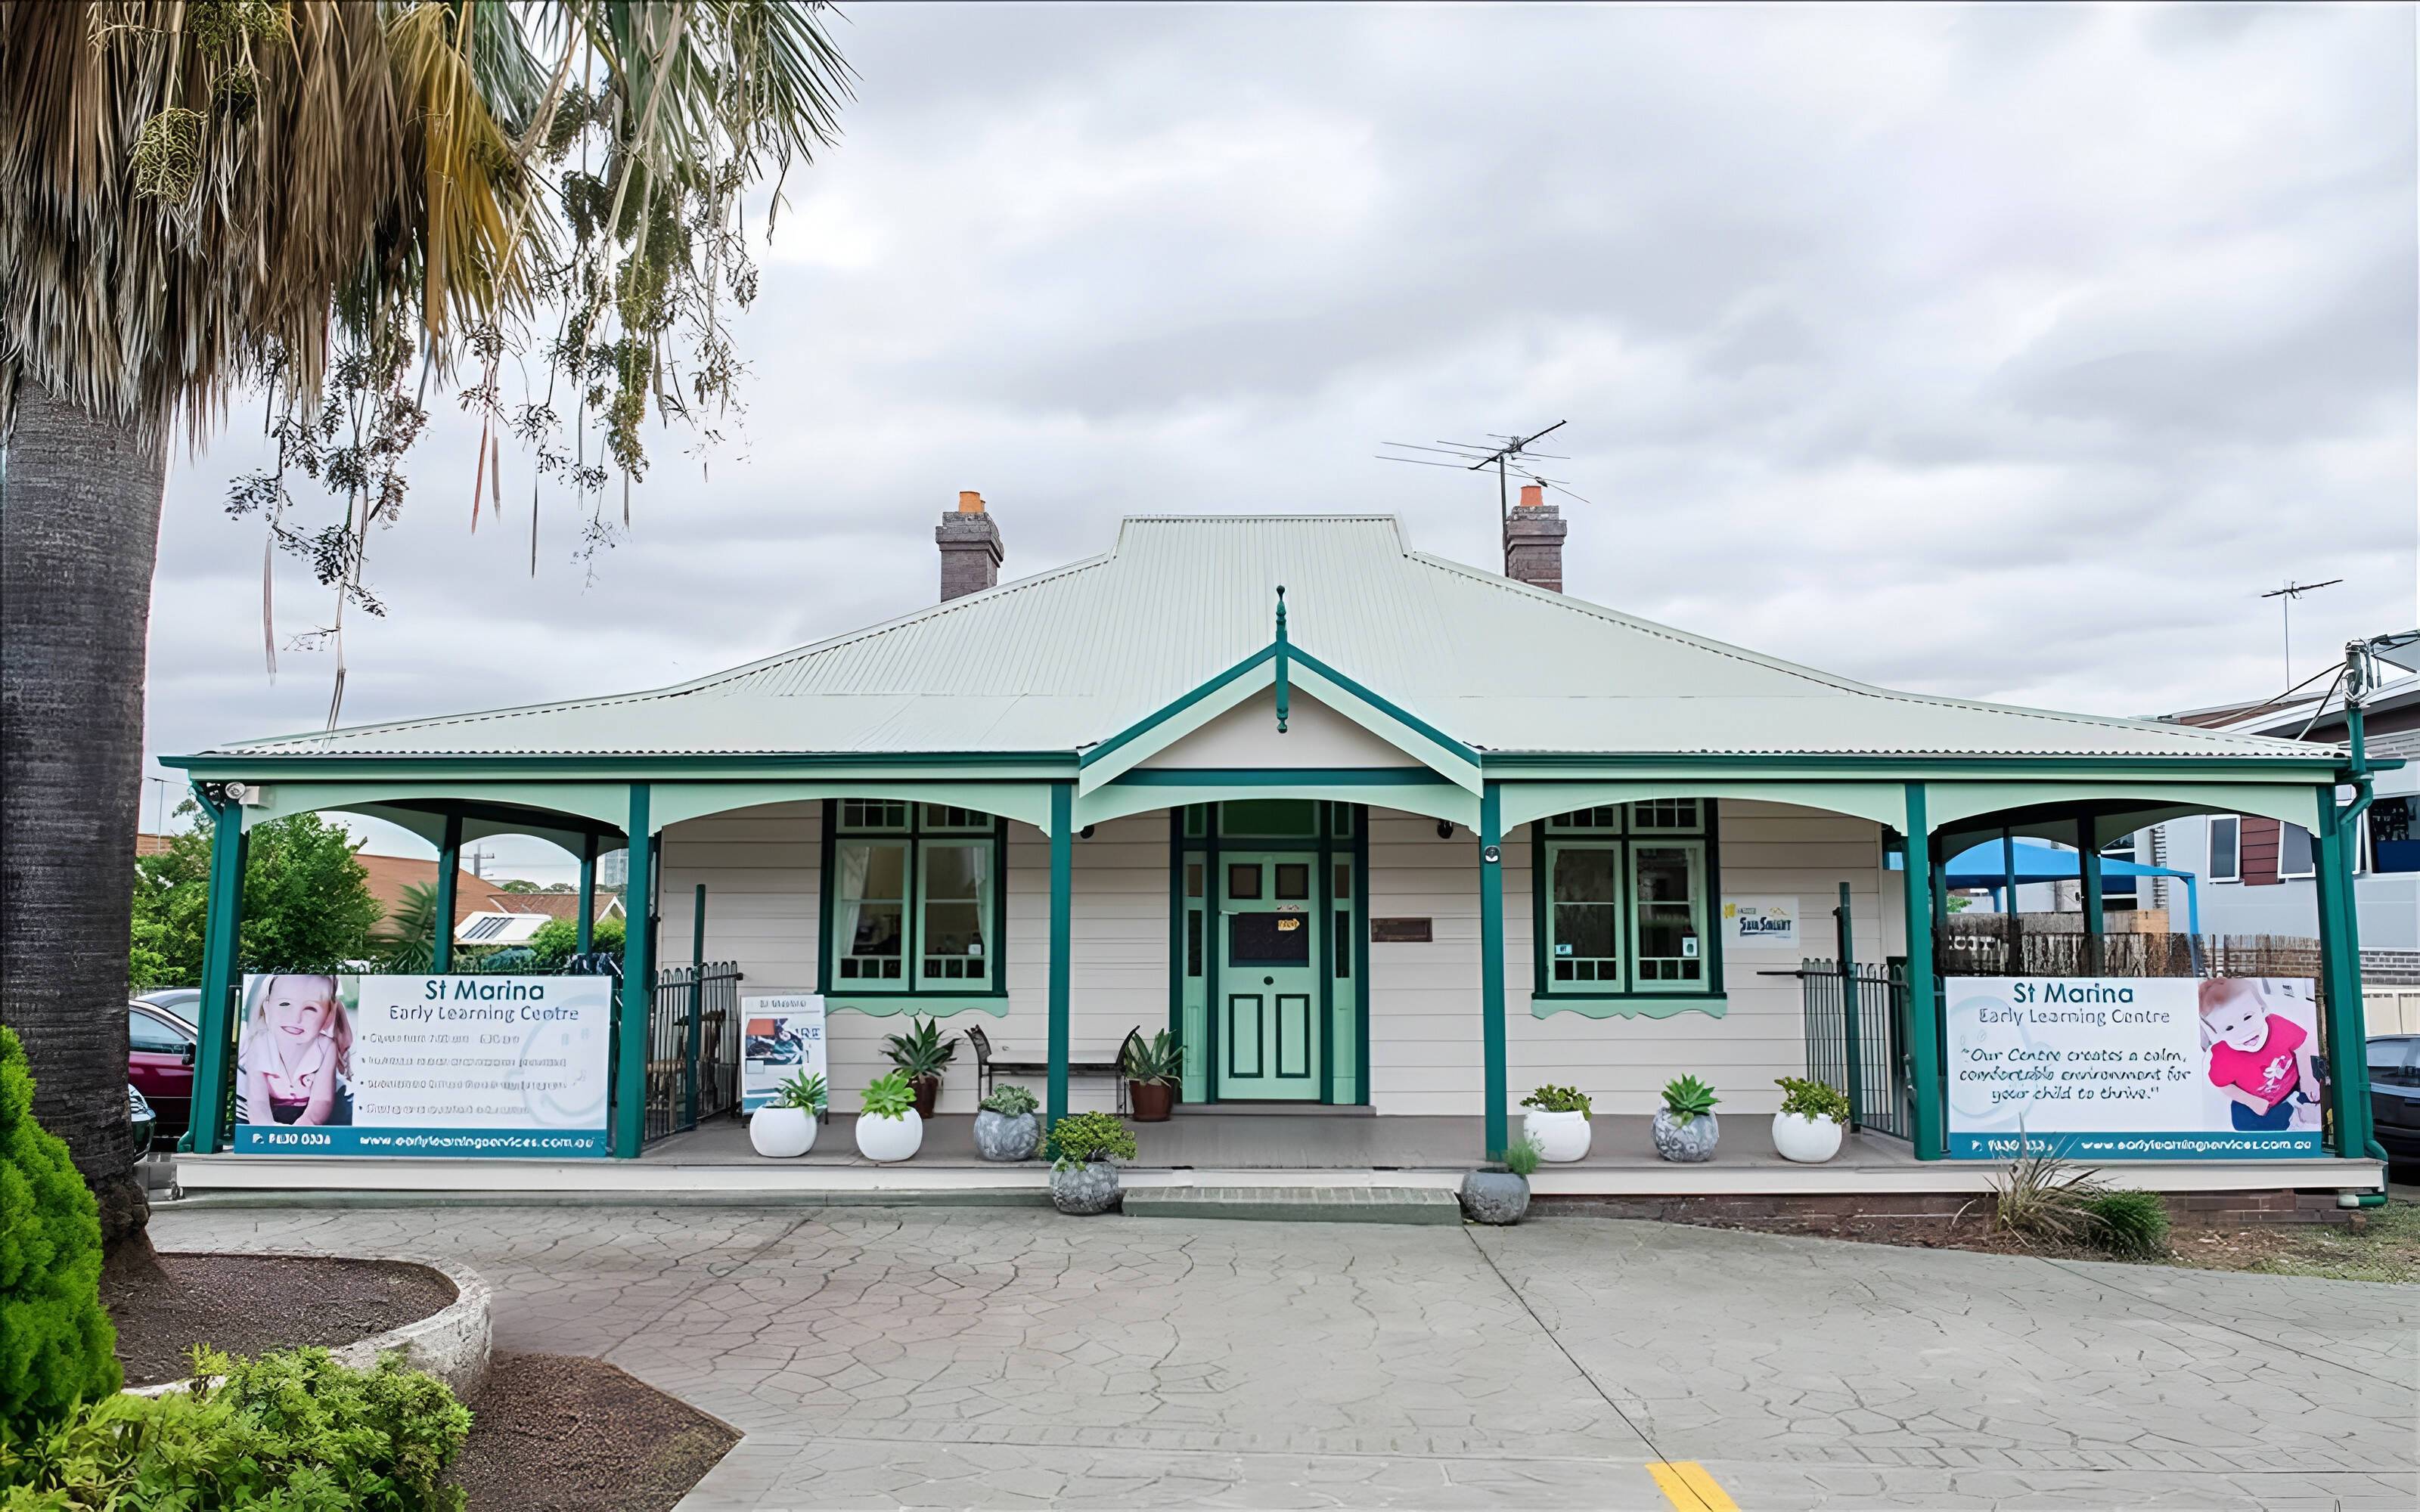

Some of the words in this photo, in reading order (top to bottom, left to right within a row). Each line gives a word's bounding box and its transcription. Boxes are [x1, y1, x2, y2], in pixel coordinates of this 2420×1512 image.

[425, 980, 446, 999] St
[454, 980, 544, 1000] Marina
[2013, 982, 2035, 1003] St
[2044, 983, 2133, 1003] Marina
[389, 1005, 433, 1022] Early
[1979, 1007, 2022, 1026] Early
[2030, 1009, 2105, 1027] Learning
[2129, 1052, 2138, 1061] a
[2033, 1086, 2071, 1100] child
